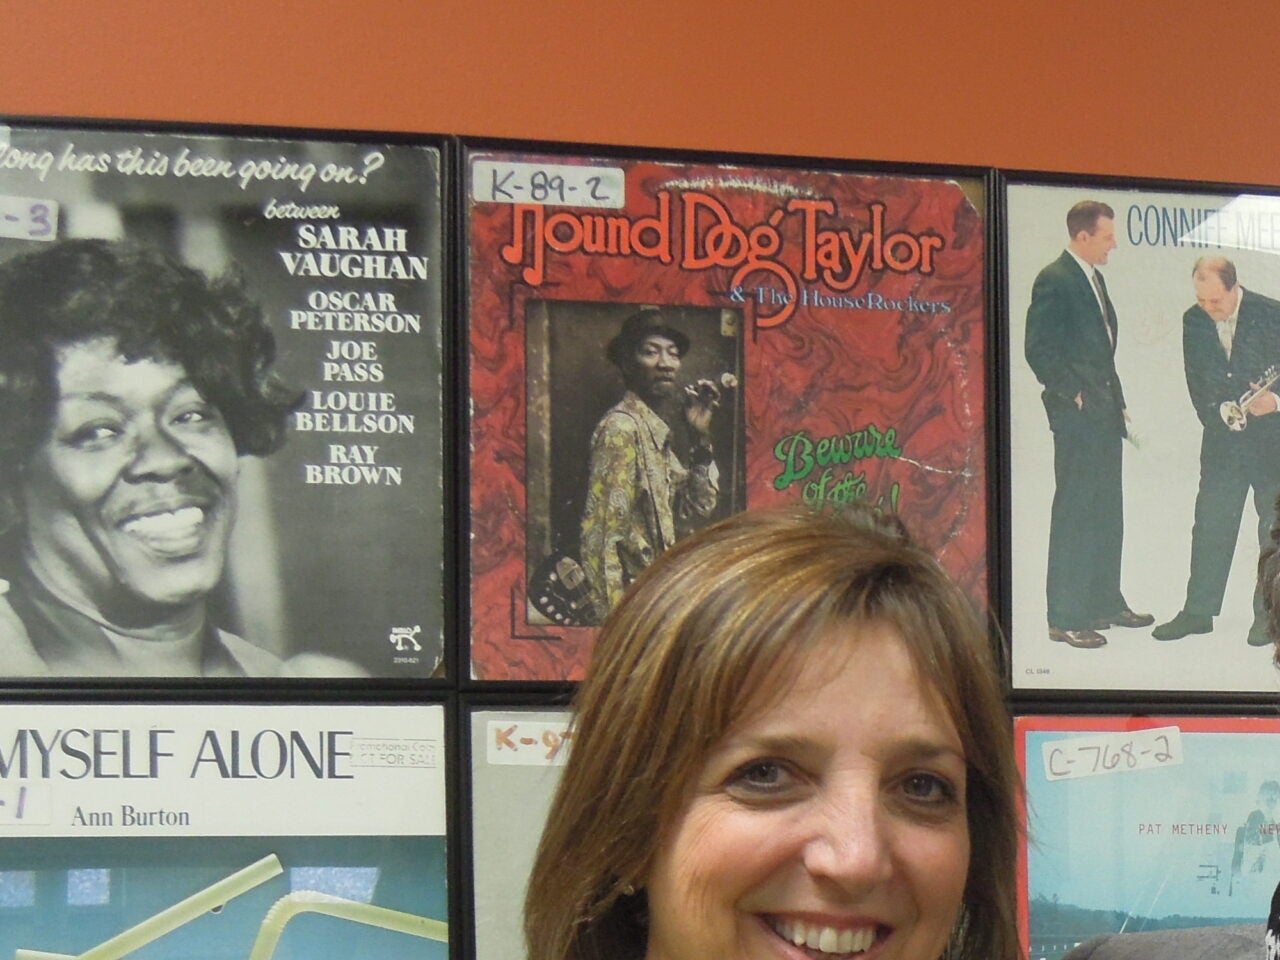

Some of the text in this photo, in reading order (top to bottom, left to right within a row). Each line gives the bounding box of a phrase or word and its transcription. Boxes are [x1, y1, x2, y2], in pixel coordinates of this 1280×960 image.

[58, 143, 111, 172] has
[117, 147, 169, 176] this
[173, 148, 235, 178] been
[239, 156, 316, 192] going
[320, 151, 385, 185] on?
[492, 169, 609, 202] K-89-2
[263, 199, 340, 219] between
[298, 224, 408, 252] SARAH
[1127, 204, 1226, 250] CONNIFF
[280, 252, 429, 280] VAUGHAN
[682, 192, 797, 327] Dog
[788, 200, 942, 290] Taylor
[308, 290, 398, 313] OSCAR
[730, 286, 745, 303] &
[754, 287, 794, 305] The
[290, 310, 421, 334] PETERSON
[326, 341, 378, 361] JOE
[323, 361, 385, 383] PASS
[312, 390, 396, 412] LOUIE
[294, 410, 415, 434] BELLSON
[328, 444, 380, 464] RAY
[775, 424, 902, 489] Beware
[304, 464, 402, 486] BROWN
[0, 729, 354, 779] MYSELF ALONE
[1050, 735, 1173, 776] C-768-2
[72, 804, 191, 827] Ann Burton
[1138, 823, 1162, 835] PAT
[1172, 823, 1228, 835] METHENY
